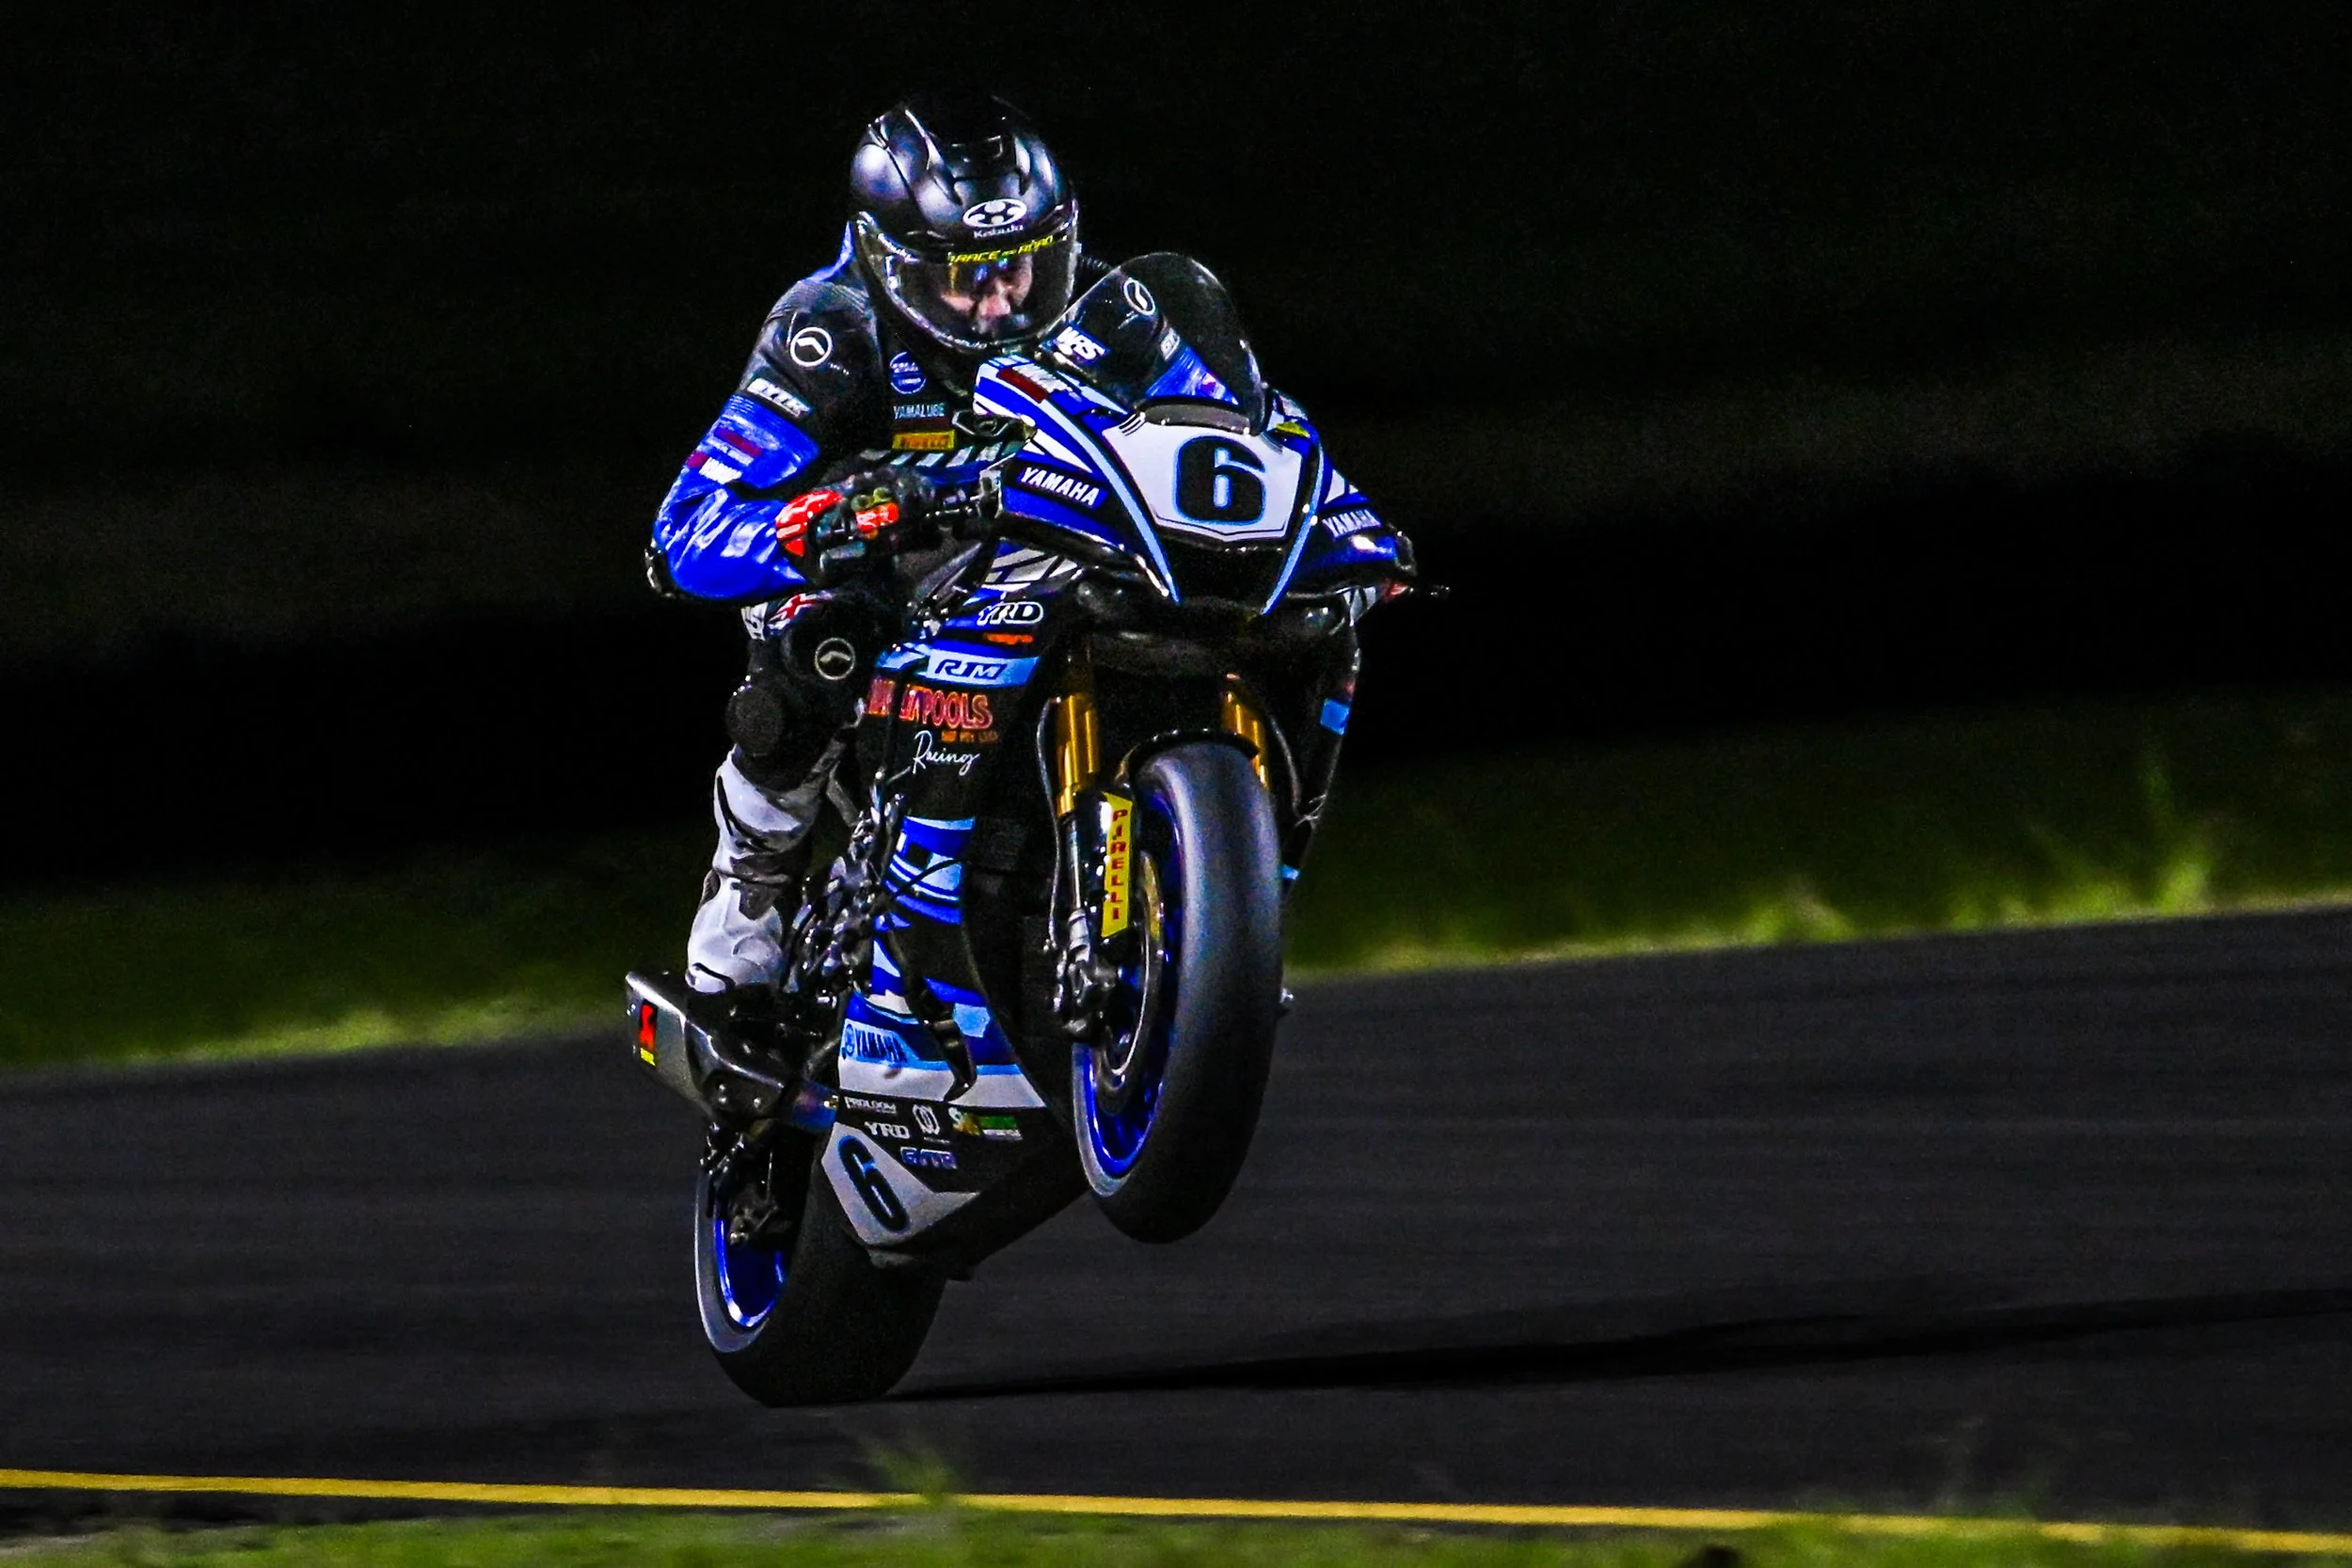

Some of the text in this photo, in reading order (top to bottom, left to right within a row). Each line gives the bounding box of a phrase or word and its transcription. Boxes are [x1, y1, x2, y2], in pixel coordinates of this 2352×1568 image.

[893, 402, 946, 420] YAMALUBE
[1020, 467, 1100, 507] YAMAHA
[1174, 436, 1266, 526] 6
[1321, 509, 1382, 538] YAMAHA
[1109, 808, 1129, 921] PIRELLI
[856, 1028, 909, 1065] YAMAHA
[865, 1120, 911, 1140] YRD
[837, 1134, 911, 1234] 6
